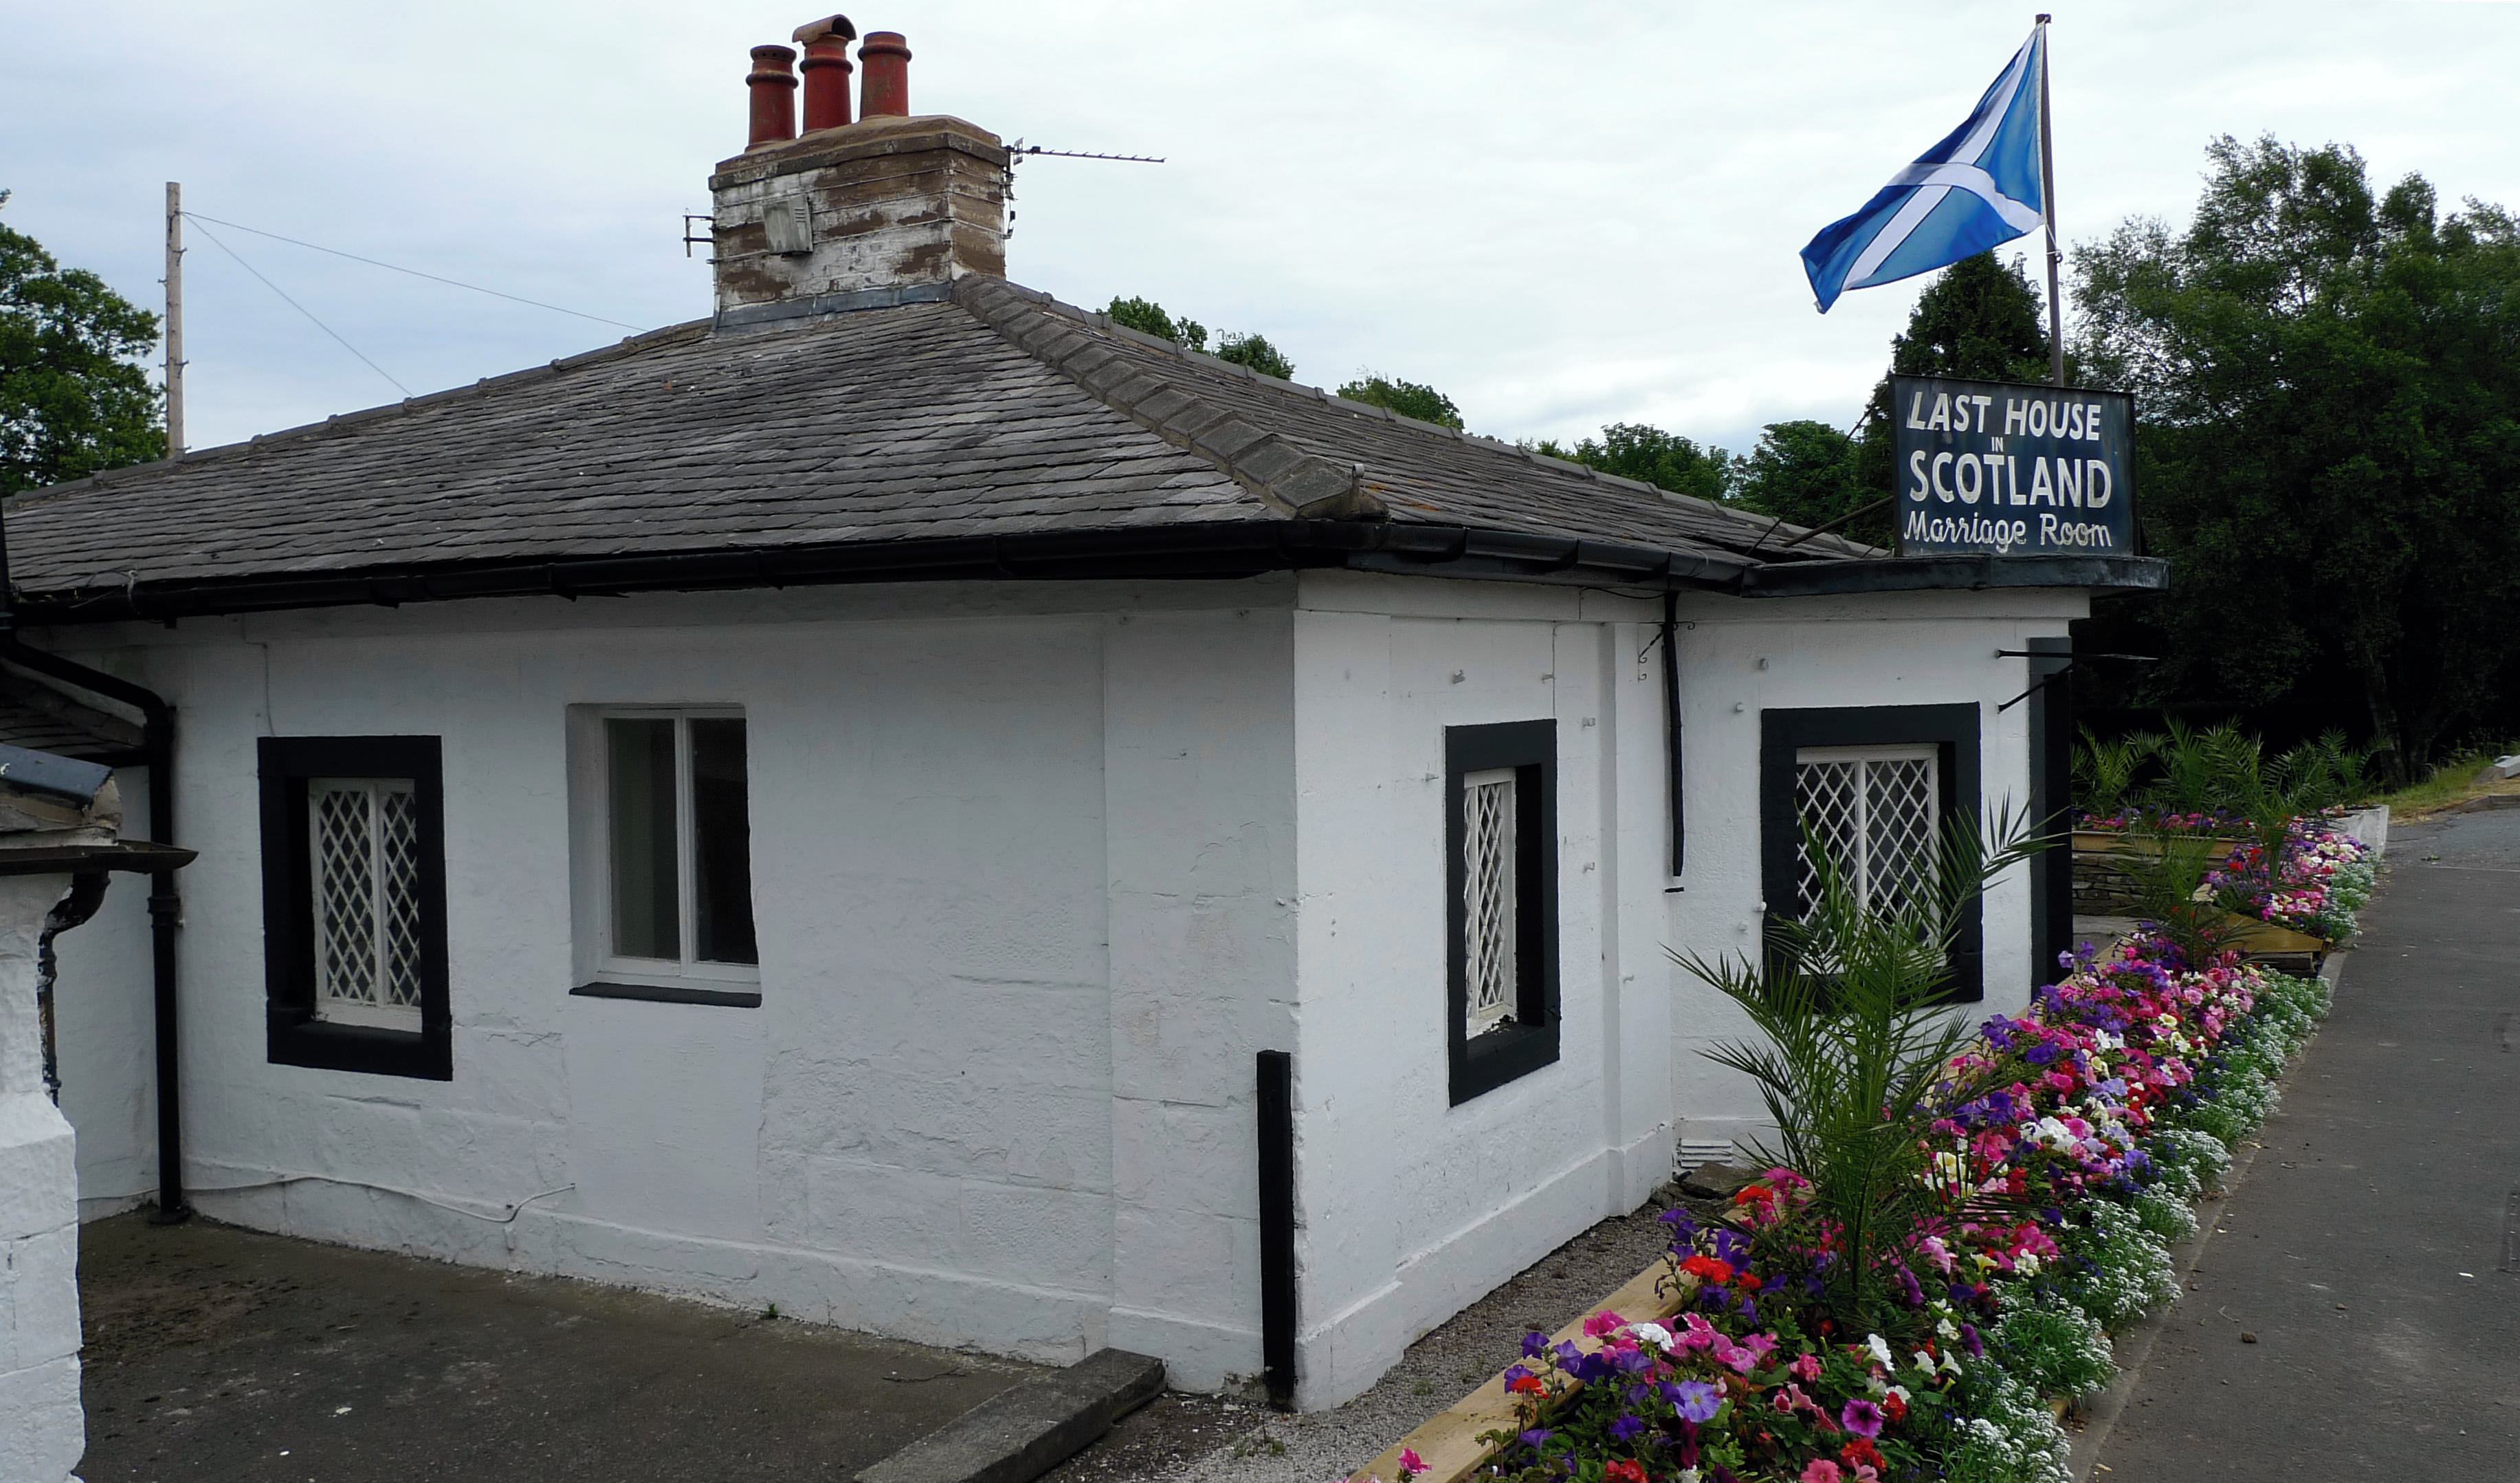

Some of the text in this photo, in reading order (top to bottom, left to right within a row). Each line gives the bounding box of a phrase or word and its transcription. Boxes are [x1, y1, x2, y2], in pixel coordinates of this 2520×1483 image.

[1906, 391, 2101, 441] LAST HOUSE
[1991, 437, 2004, 452] IN
[1909, 450, 2112, 508] SCOTLAND
[1904, 510, 2112, 553] Marriage Room
